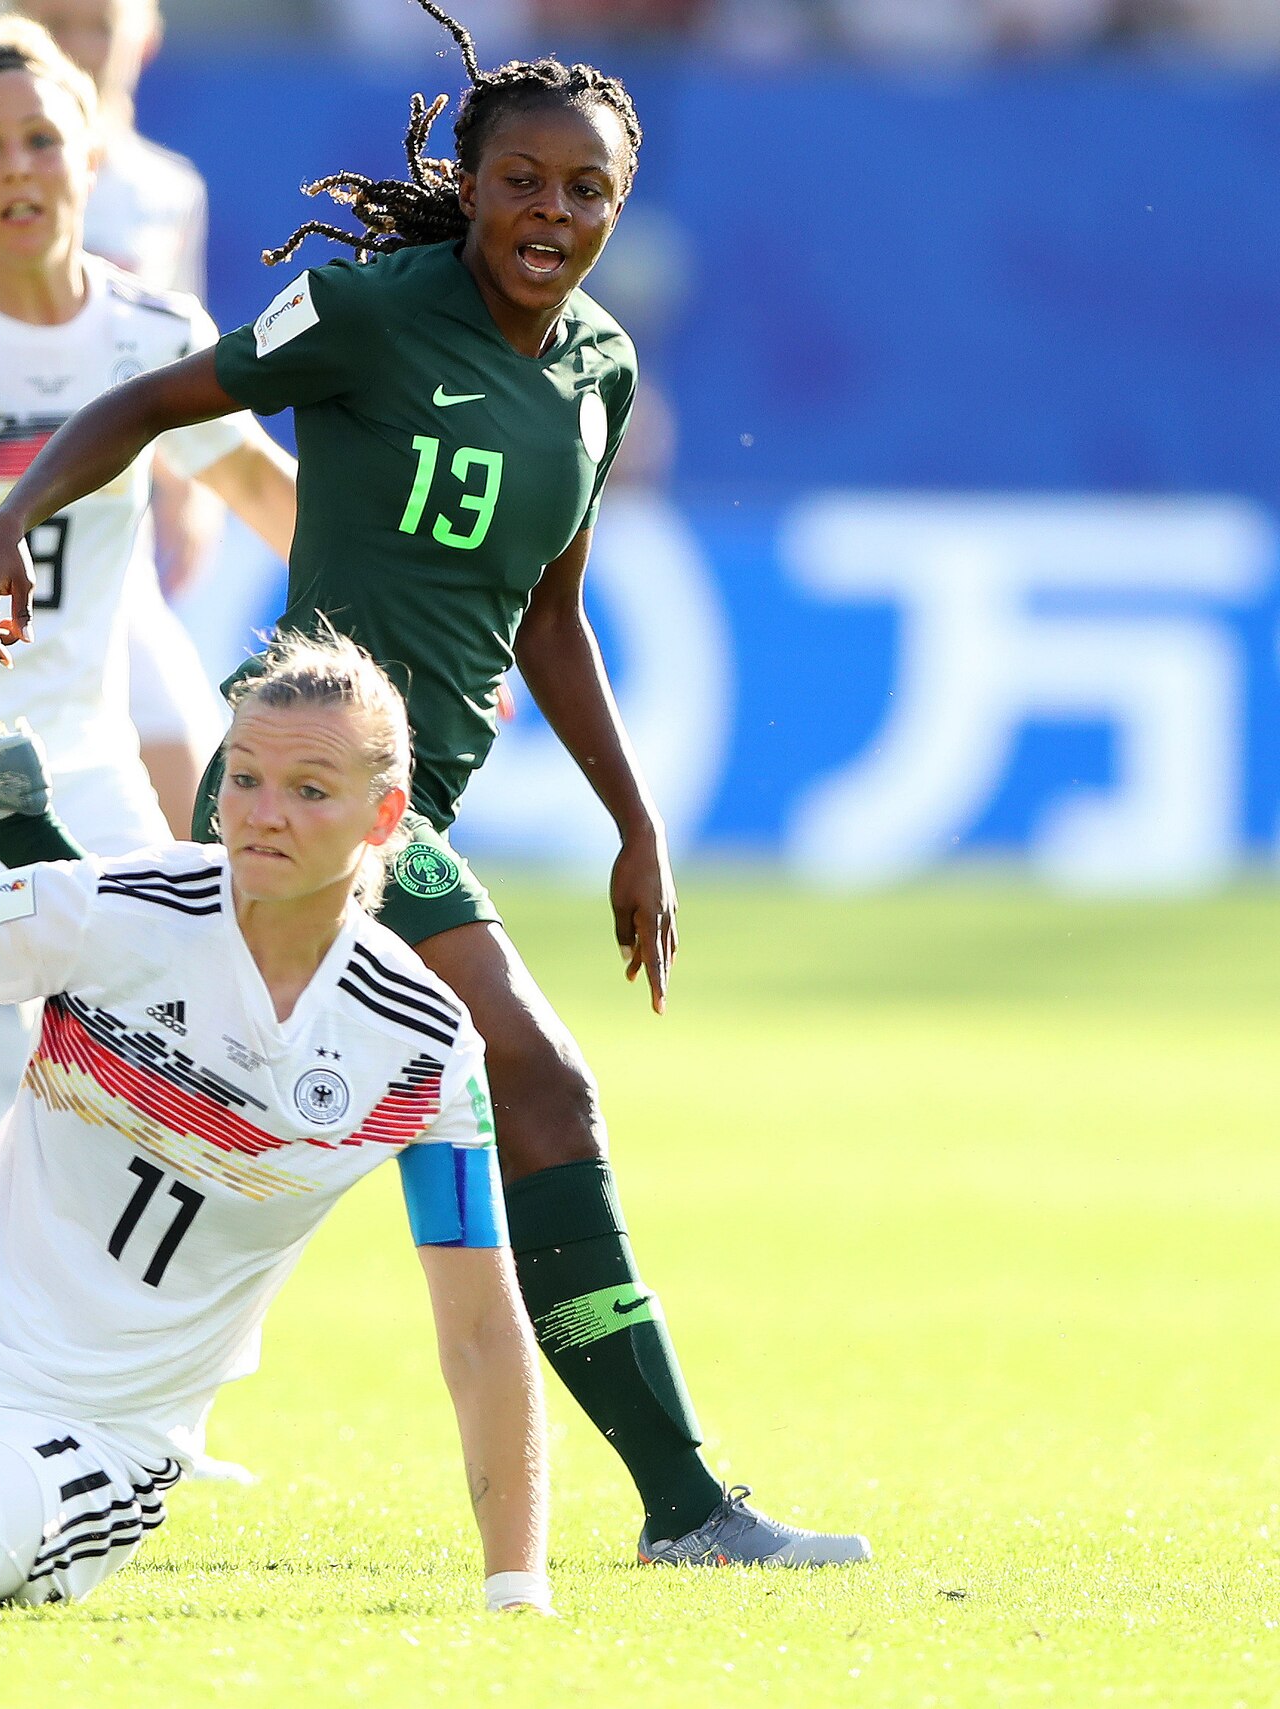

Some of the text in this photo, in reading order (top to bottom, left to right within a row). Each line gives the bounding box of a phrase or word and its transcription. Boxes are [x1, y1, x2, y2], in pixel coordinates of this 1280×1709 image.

[398, 433, 504, 550] 13
[777, 490, 1273, 894] 万
[146, 1006, 188, 1036] adidas
[107, 1156, 206, 1288] 11
